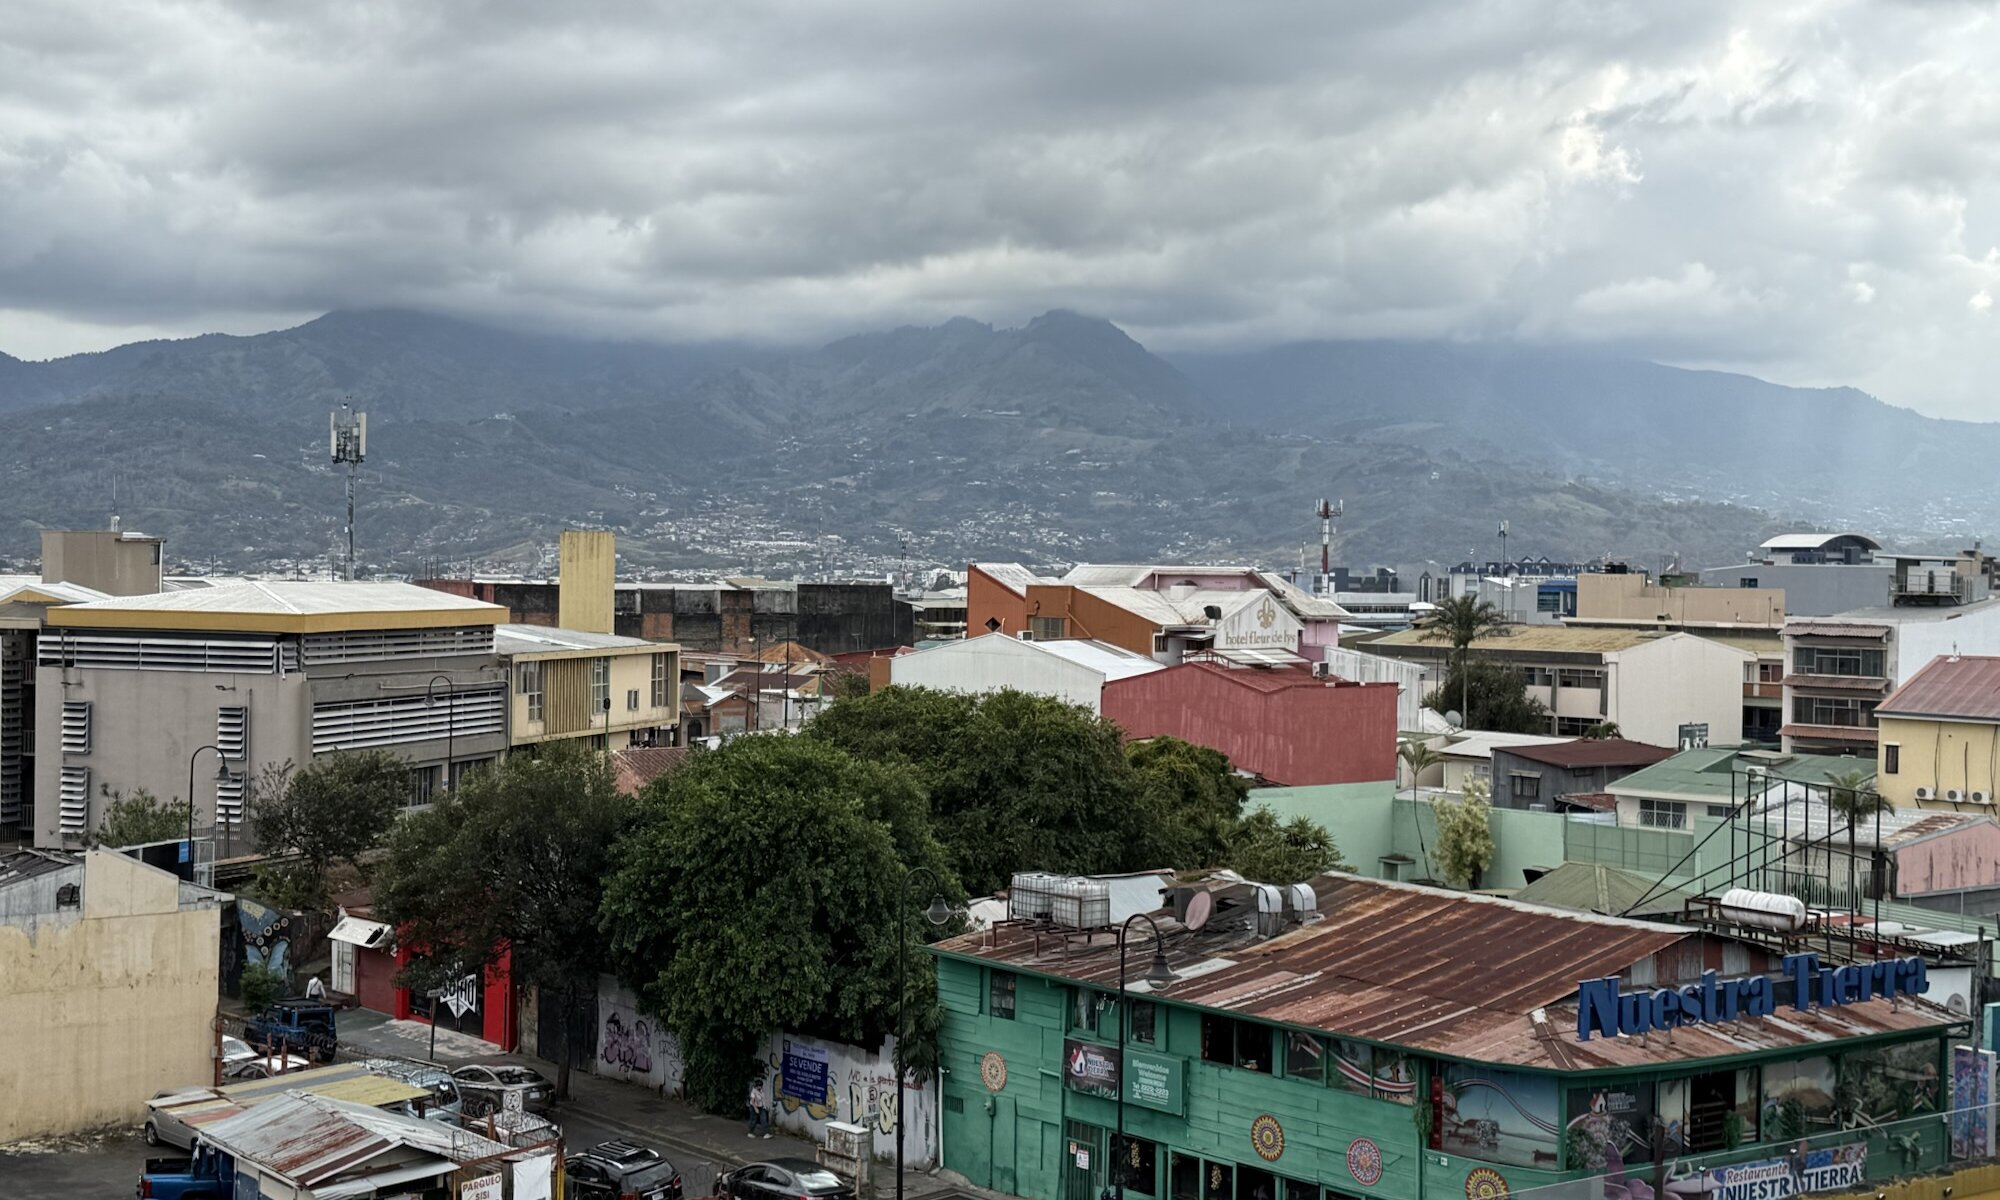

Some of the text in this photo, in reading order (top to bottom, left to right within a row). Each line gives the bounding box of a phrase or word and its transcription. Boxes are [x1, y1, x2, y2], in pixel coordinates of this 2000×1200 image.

[1226, 629, 1297, 645] hotel fleur de lys
[1576, 952, 1930, 1042] Nuestra Tierra
[790, 1056, 823, 1073] SE VENDE
[1087, 1058, 1114, 1071] NUESTRA
[1726, 1162, 1788, 1184] Restaurante
[1804, 1165, 1860, 1191] TIERRA
[462, 1175, 501, 1192] PARQUEO
[475, 1190, 490, 1200] SISI
